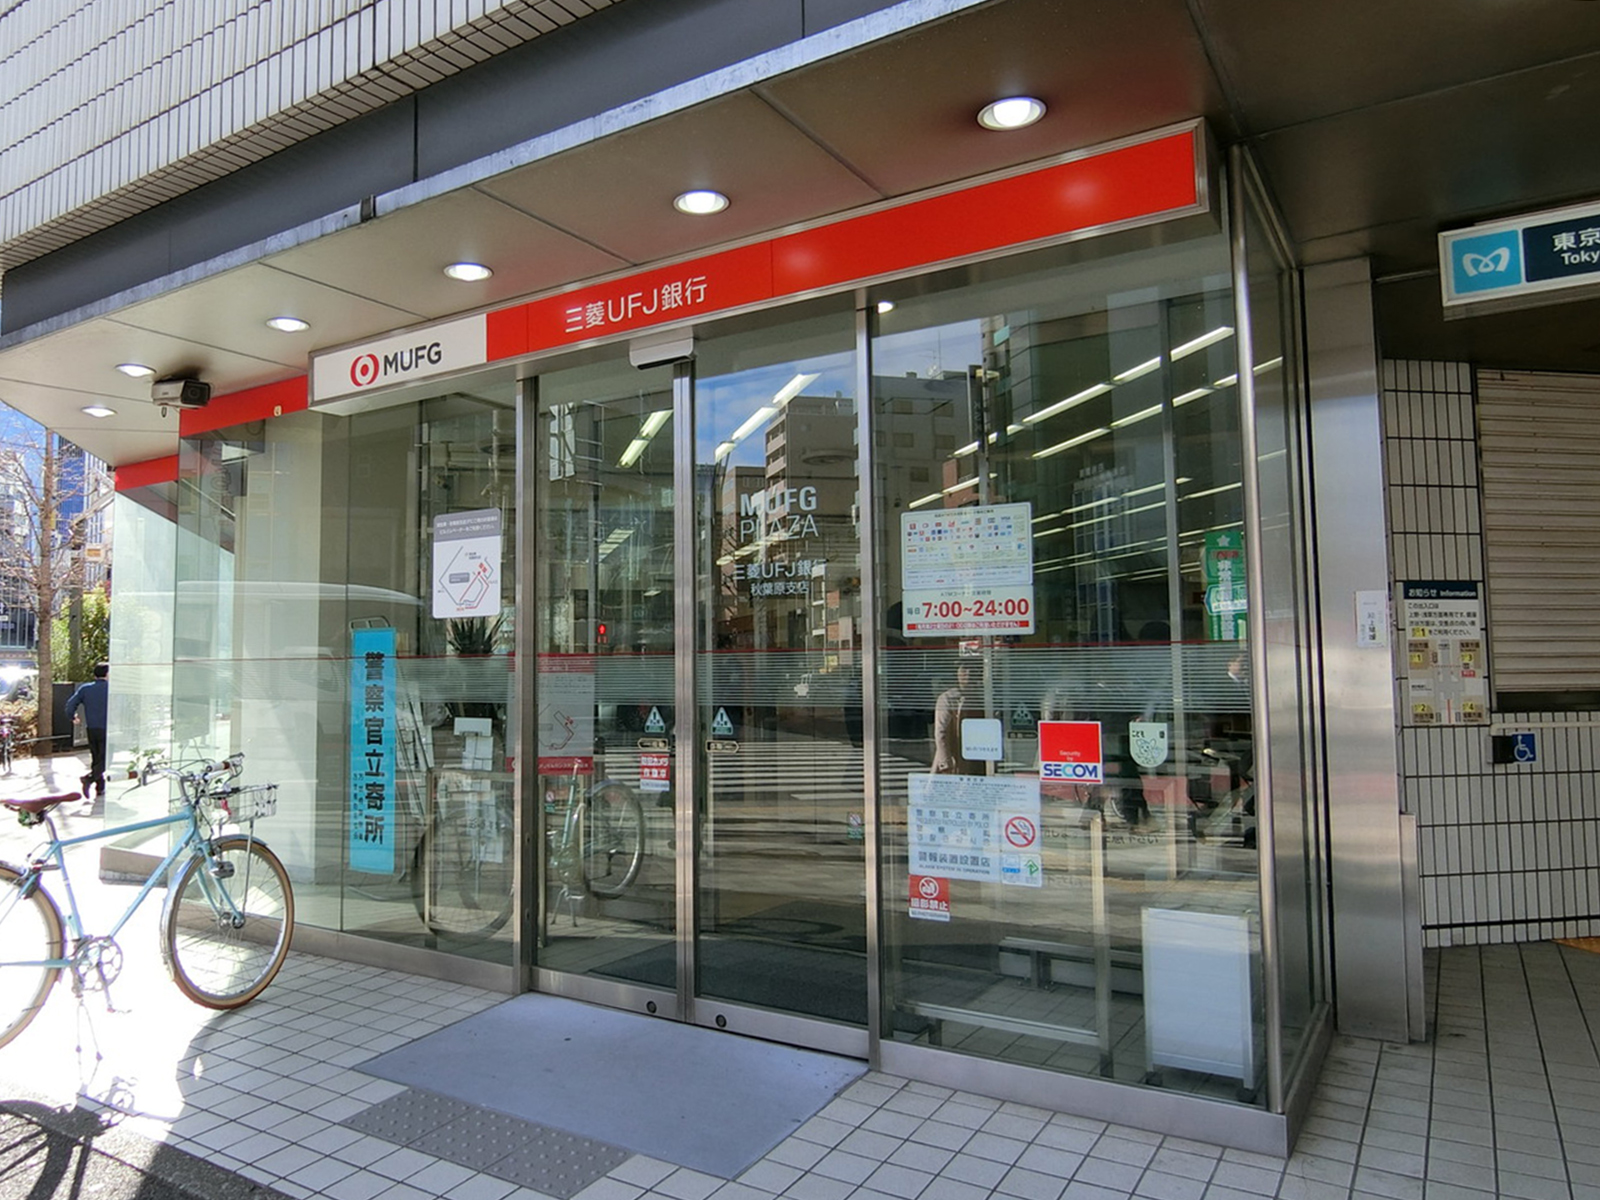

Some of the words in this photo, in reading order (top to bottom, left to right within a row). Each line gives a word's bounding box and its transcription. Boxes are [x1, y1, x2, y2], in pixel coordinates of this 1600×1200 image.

[1552, 227, 1600, 252] 東京
[565, 276, 708, 334] 三菱UFJ銀行
[383, 342, 442, 376] MUFG
[740, 486, 817, 517] MUFG
[740, 514, 819, 542] PLAZA
[751, 581, 809, 597] 秋葉原支店
[1408, 588, 1437, 597] お知らせ
[906, 607, 920, 615] 毎日
[364, 651, 386, 845] 警察官立寄所
[1043, 763, 1098, 778] SECOM
